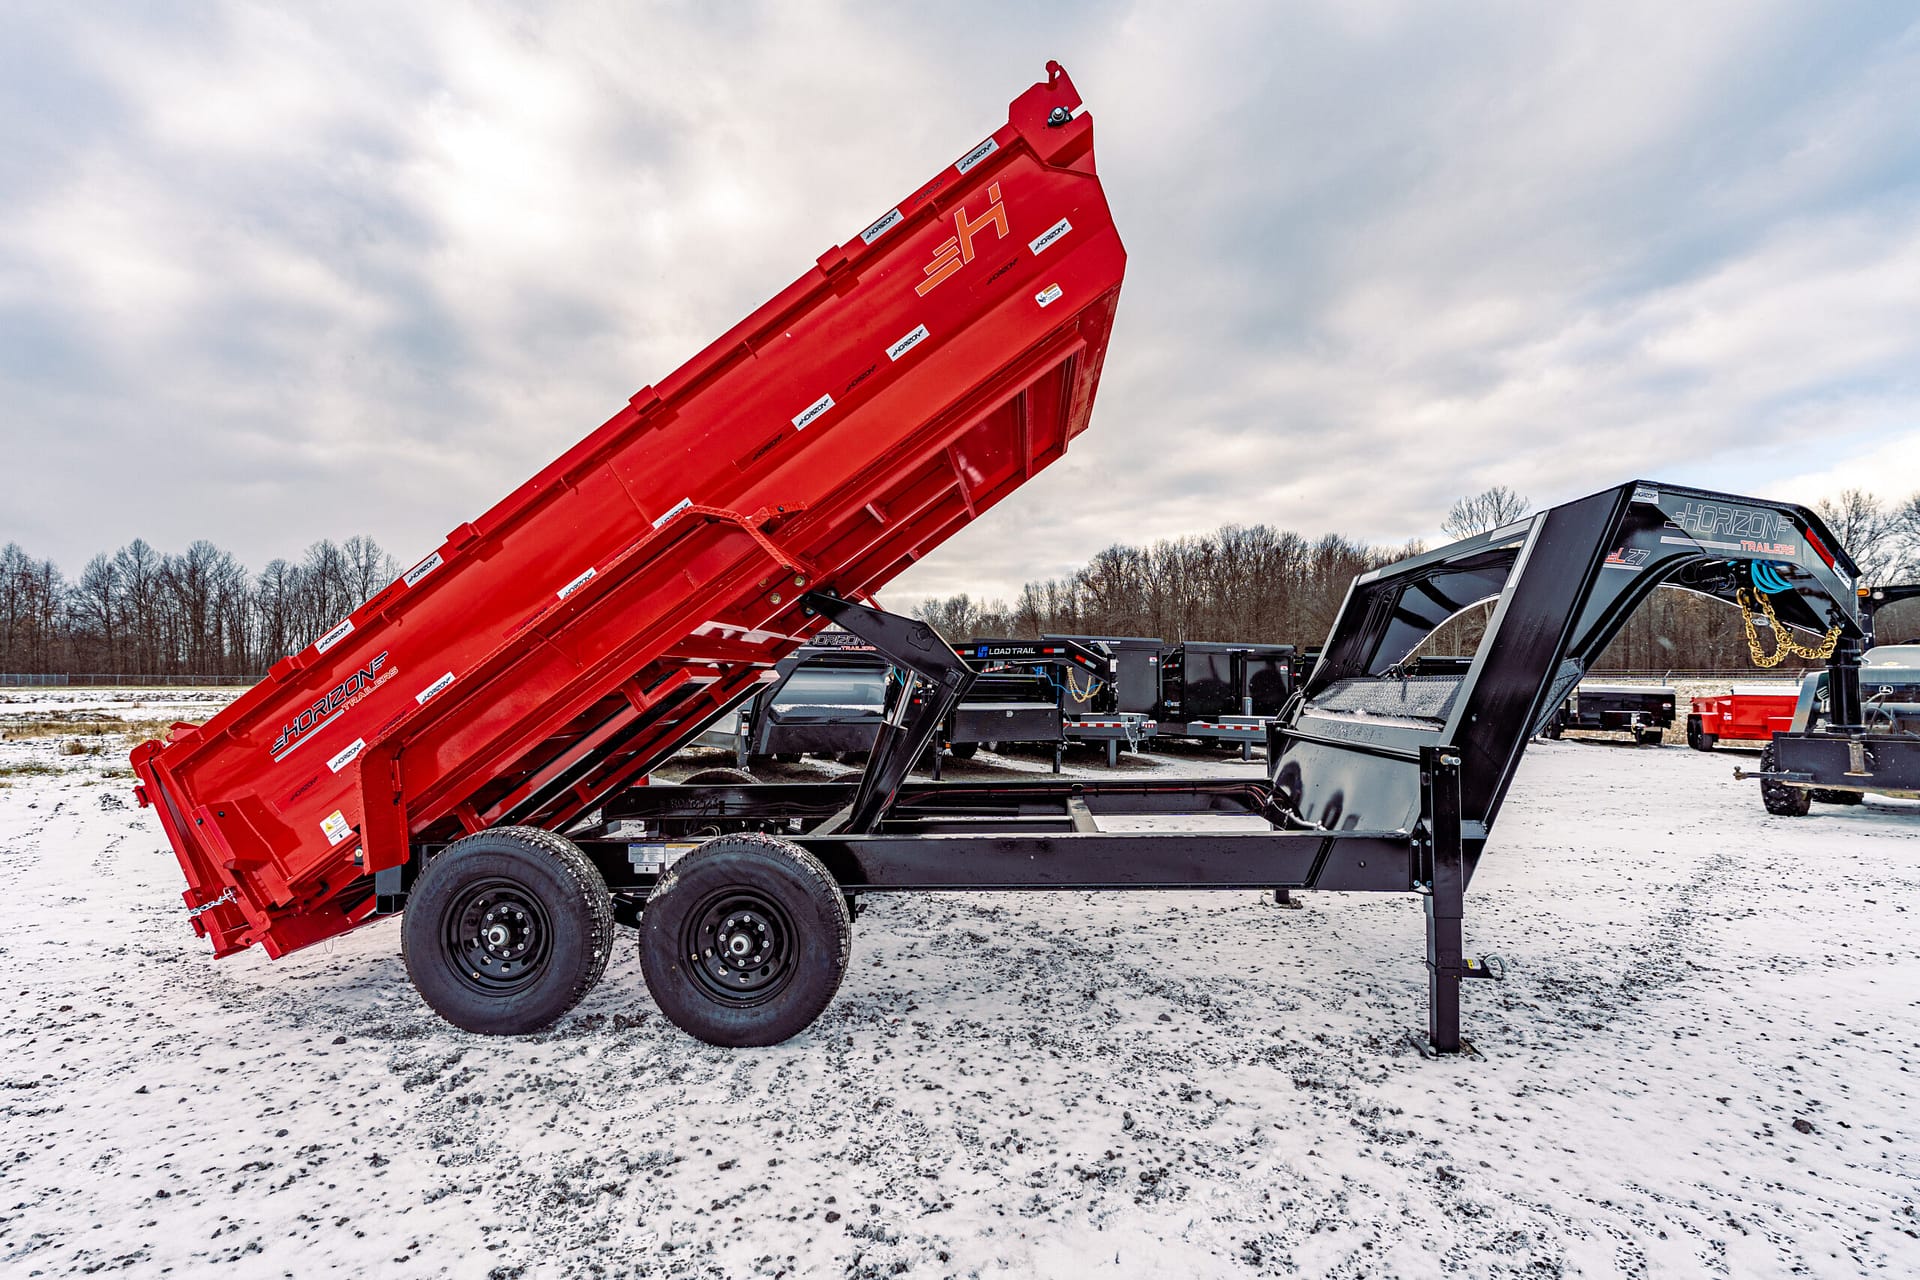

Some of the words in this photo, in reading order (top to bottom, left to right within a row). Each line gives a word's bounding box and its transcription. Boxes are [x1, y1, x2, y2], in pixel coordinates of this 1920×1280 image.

[1034, 222, 1067, 251] HORIZON
[892, 329, 924, 358] HORIZON
[798, 398, 830, 427] HORIZON
[1664, 502, 1794, 541] HORIZON
[1740, 539, 1796, 556] TRAILERS
[408, 556, 439, 584] HORIZON
[319, 623, 350, 649] HORIZON
[1012, 647, 1036, 655] TRAIL
[271, 652, 388, 754] HORIZON
[342, 666, 399, 712] TRAILERS
[421, 676, 452, 703] HORIZON
[333, 742, 362, 769] HORIZON
